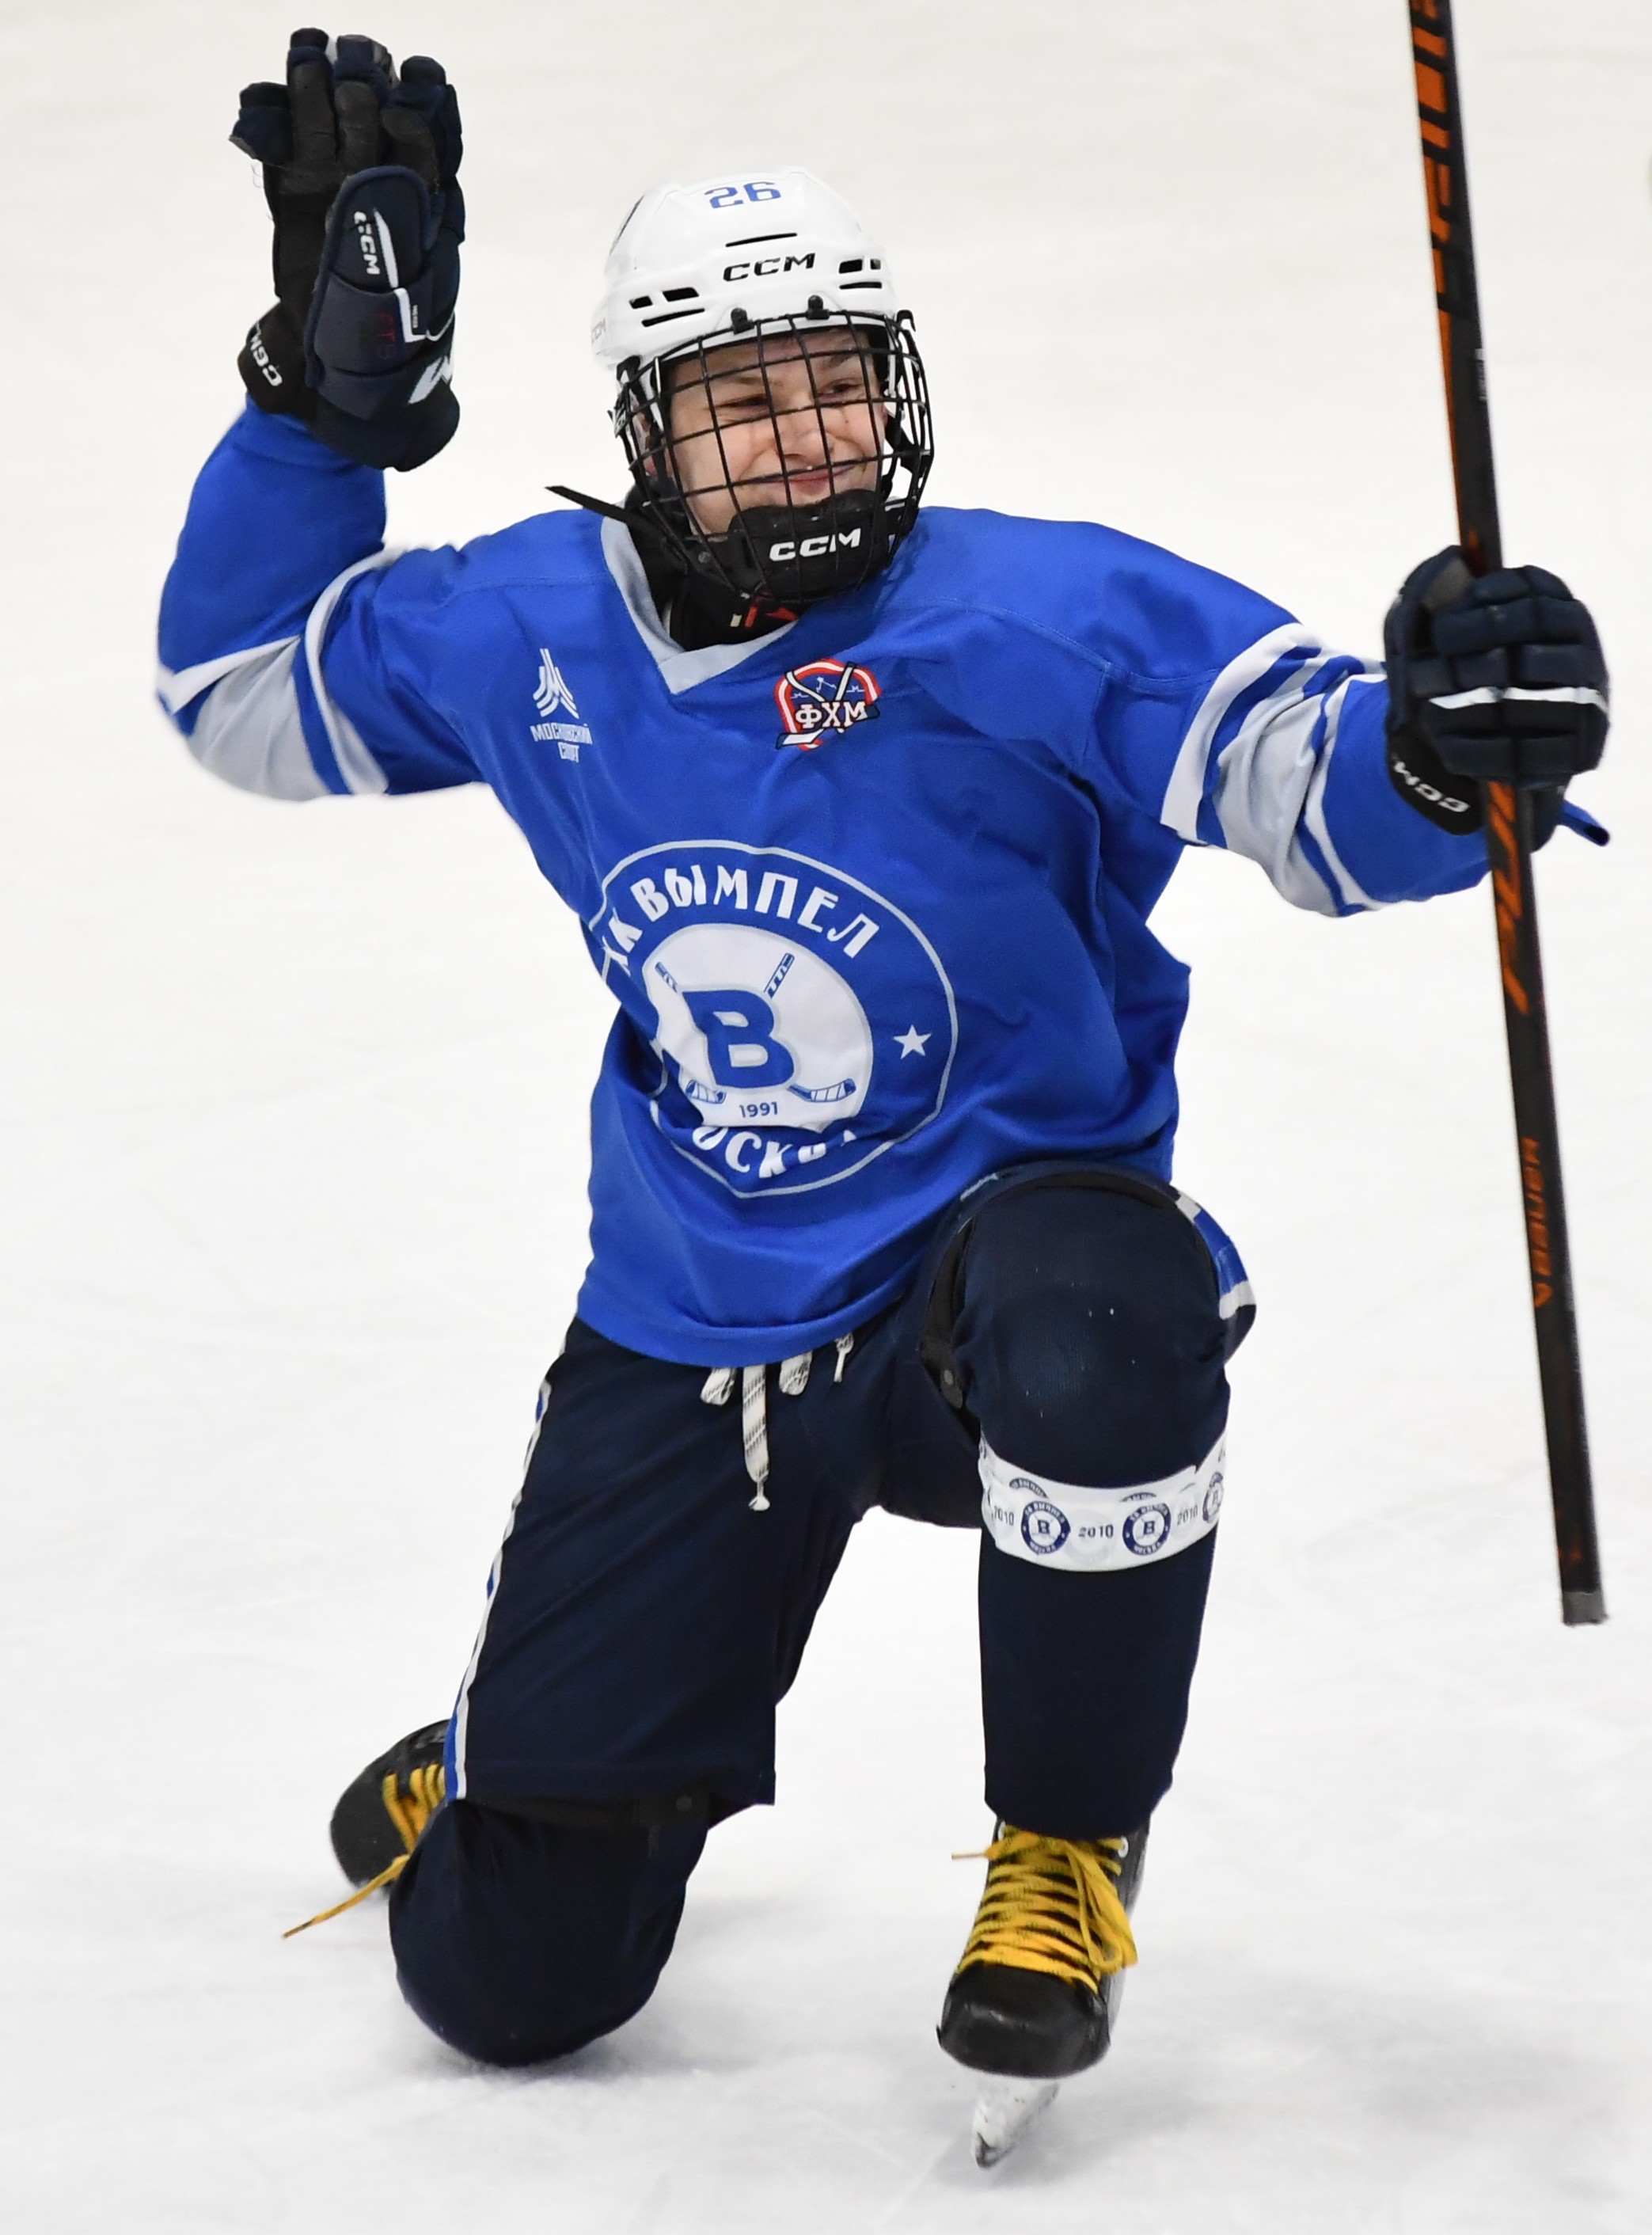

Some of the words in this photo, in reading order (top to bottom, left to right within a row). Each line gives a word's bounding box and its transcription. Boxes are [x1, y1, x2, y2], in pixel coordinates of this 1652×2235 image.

[704, 181, 782, 209] 26
[353, 211, 381, 275] CCM
[723, 253, 816, 282] CCM
[769, 528, 861, 561] CCM
[794, 699, 868, 730] ФХМ
[1393, 758, 1471, 812] CCM
[630, 865, 880, 958] ВЫМПЕЛ
[739, 1101, 779, 1118] 1991
[1176, 1505, 1198, 1526] 2010
[1078, 1524, 1114, 1538] 2010
